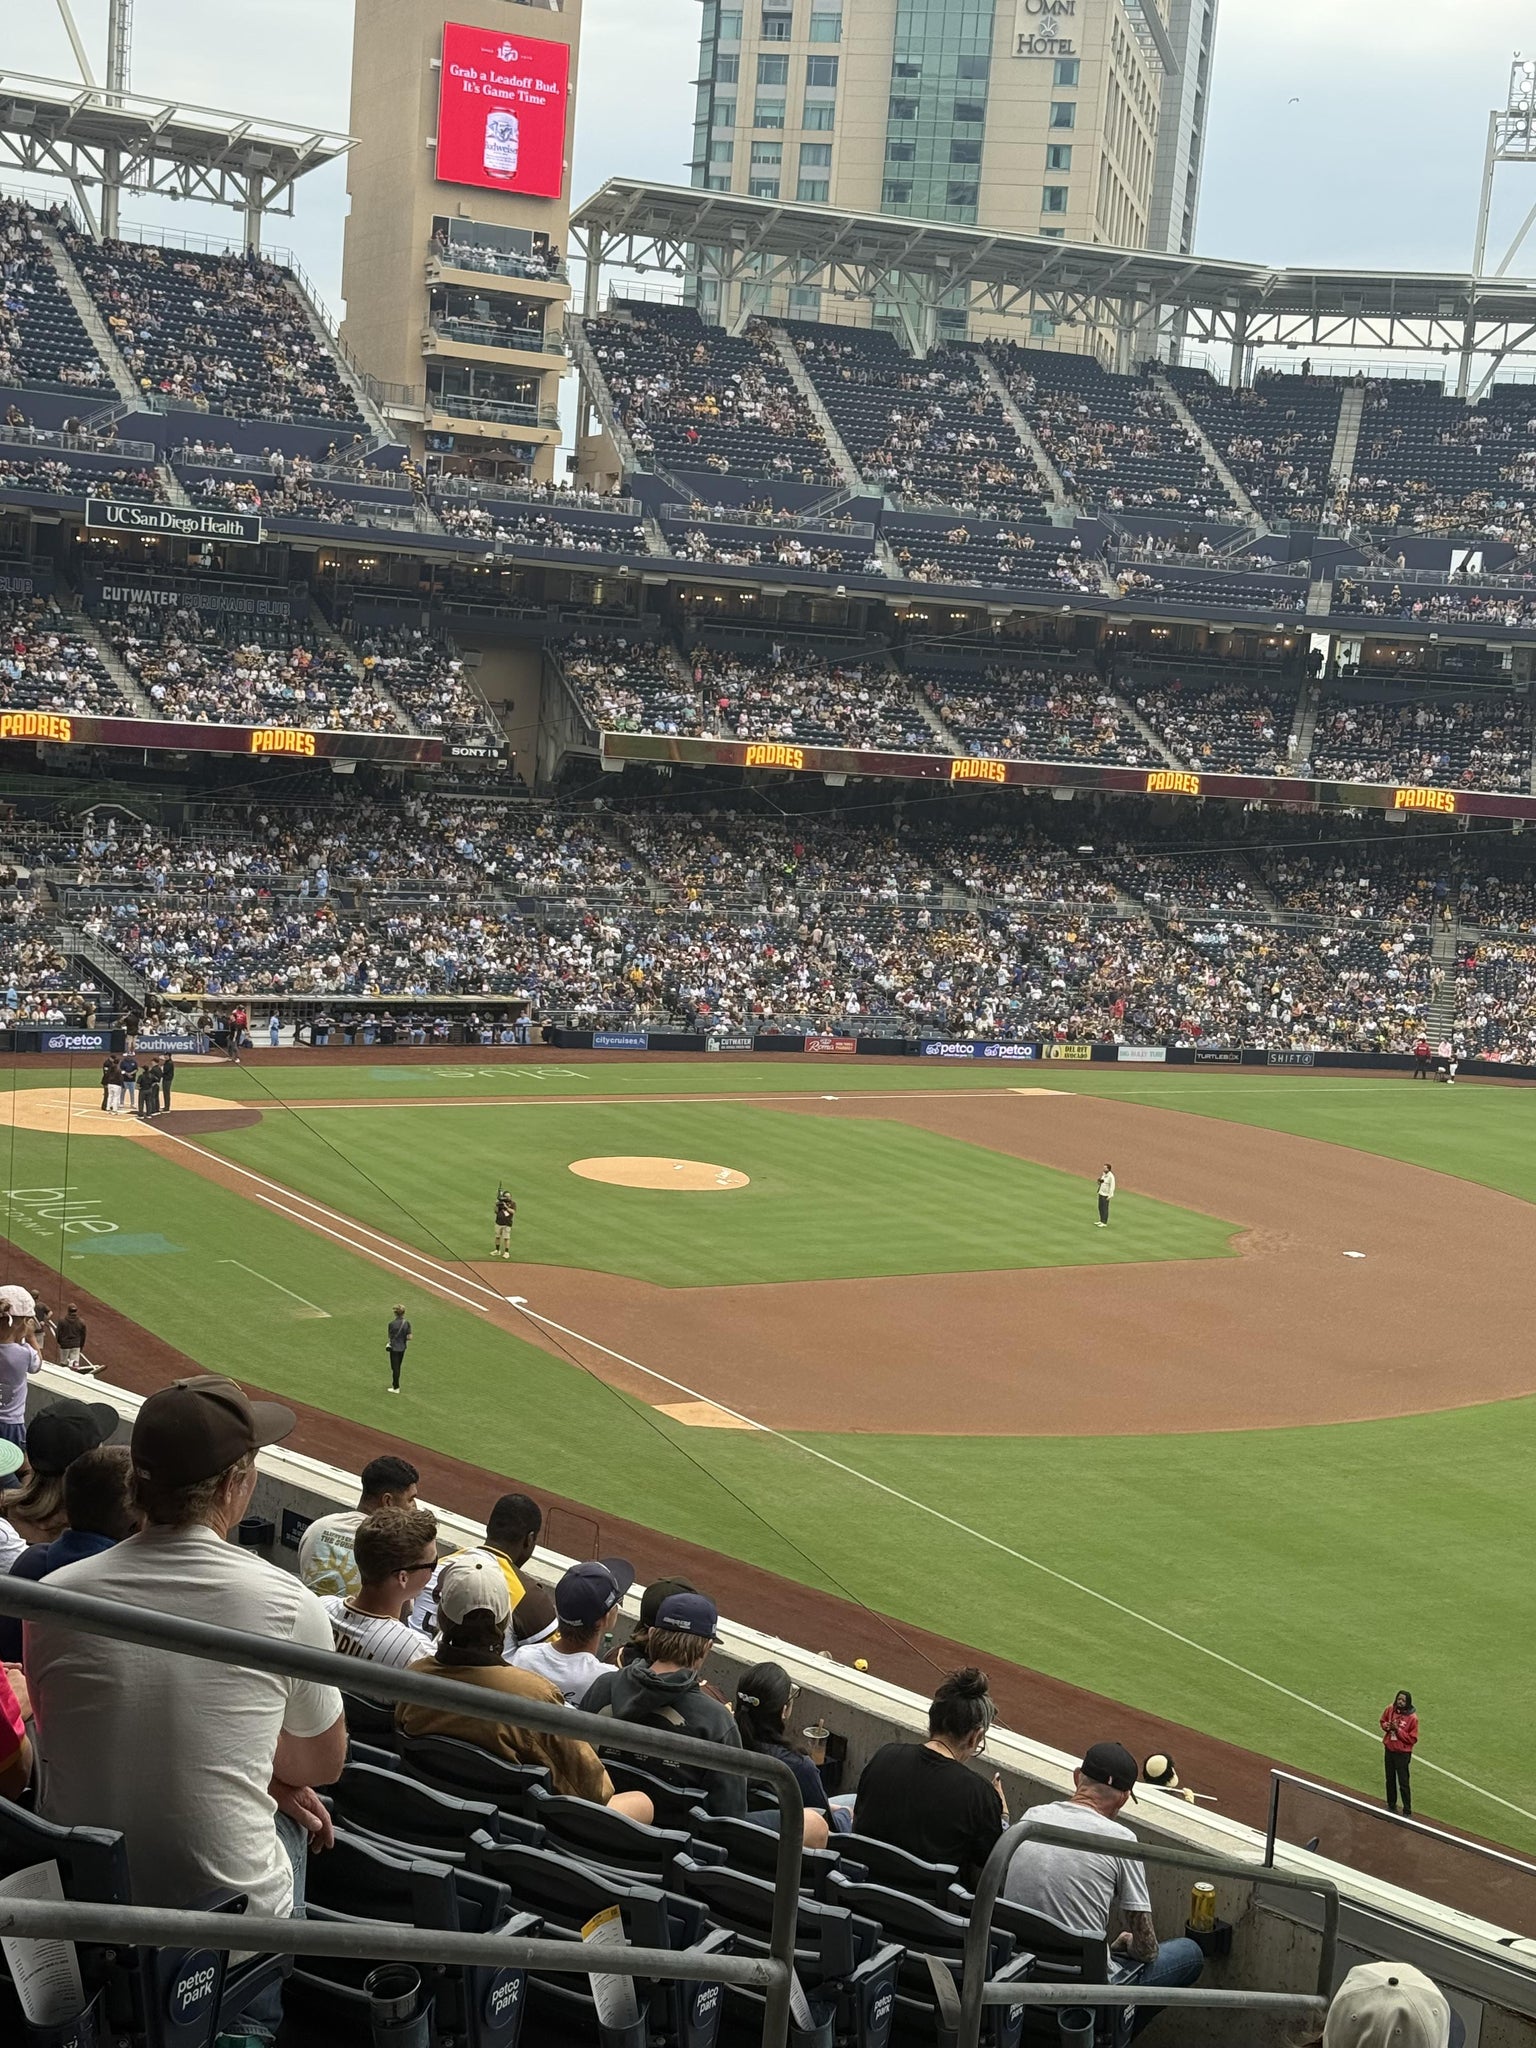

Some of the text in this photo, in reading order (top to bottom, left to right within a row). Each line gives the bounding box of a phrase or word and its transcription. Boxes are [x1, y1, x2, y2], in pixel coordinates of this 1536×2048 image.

[1026, 0, 1076, 16] OMNI
[1017, 33, 1076, 55] HOTEL
[450, 64, 560, 95] Grab a Leadoff Bud,
[463, 80, 546, 106] It's Game Time
[106, 505, 244, 536] UC San Diego Health
[102, 586, 291, 616] CUTWATER CORONADO CLUB
[0, 714, 71, 742] PADRES
[251, 729, 316, 756] PADRES
[451, 747, 487, 757] SONY
[745, 744, 804, 770] PADRES
[950, 758, 1006, 783] PADRES
[1146, 771, 1200, 795] PADRES
[1394, 789, 1456, 813] PADRES
[65, 1035, 103, 1049] petco
[134, 1038, 195, 1050] Southwest
[595, 1036, 638, 1045] citycruises
[721, 1038, 752, 1046] CUTWATER
[940, 1043, 974, 1055] petco
[999, 1045, 1032, 1057] petco
[1271, 1054, 1302, 1063] SHIFT
[1, 1187, 119, 1234] blue
[177, 1967, 215, 1999] petco
[492, 1978, 520, 2006] petco
[182, 1981, 213, 2011] park
[495, 1990, 519, 2016] park
[697, 1986, 719, 2007] petco
[699, 1996, 717, 2016] park
[874, 1994, 892, 2013] petco
[875, 2004, 891, 2021] park
